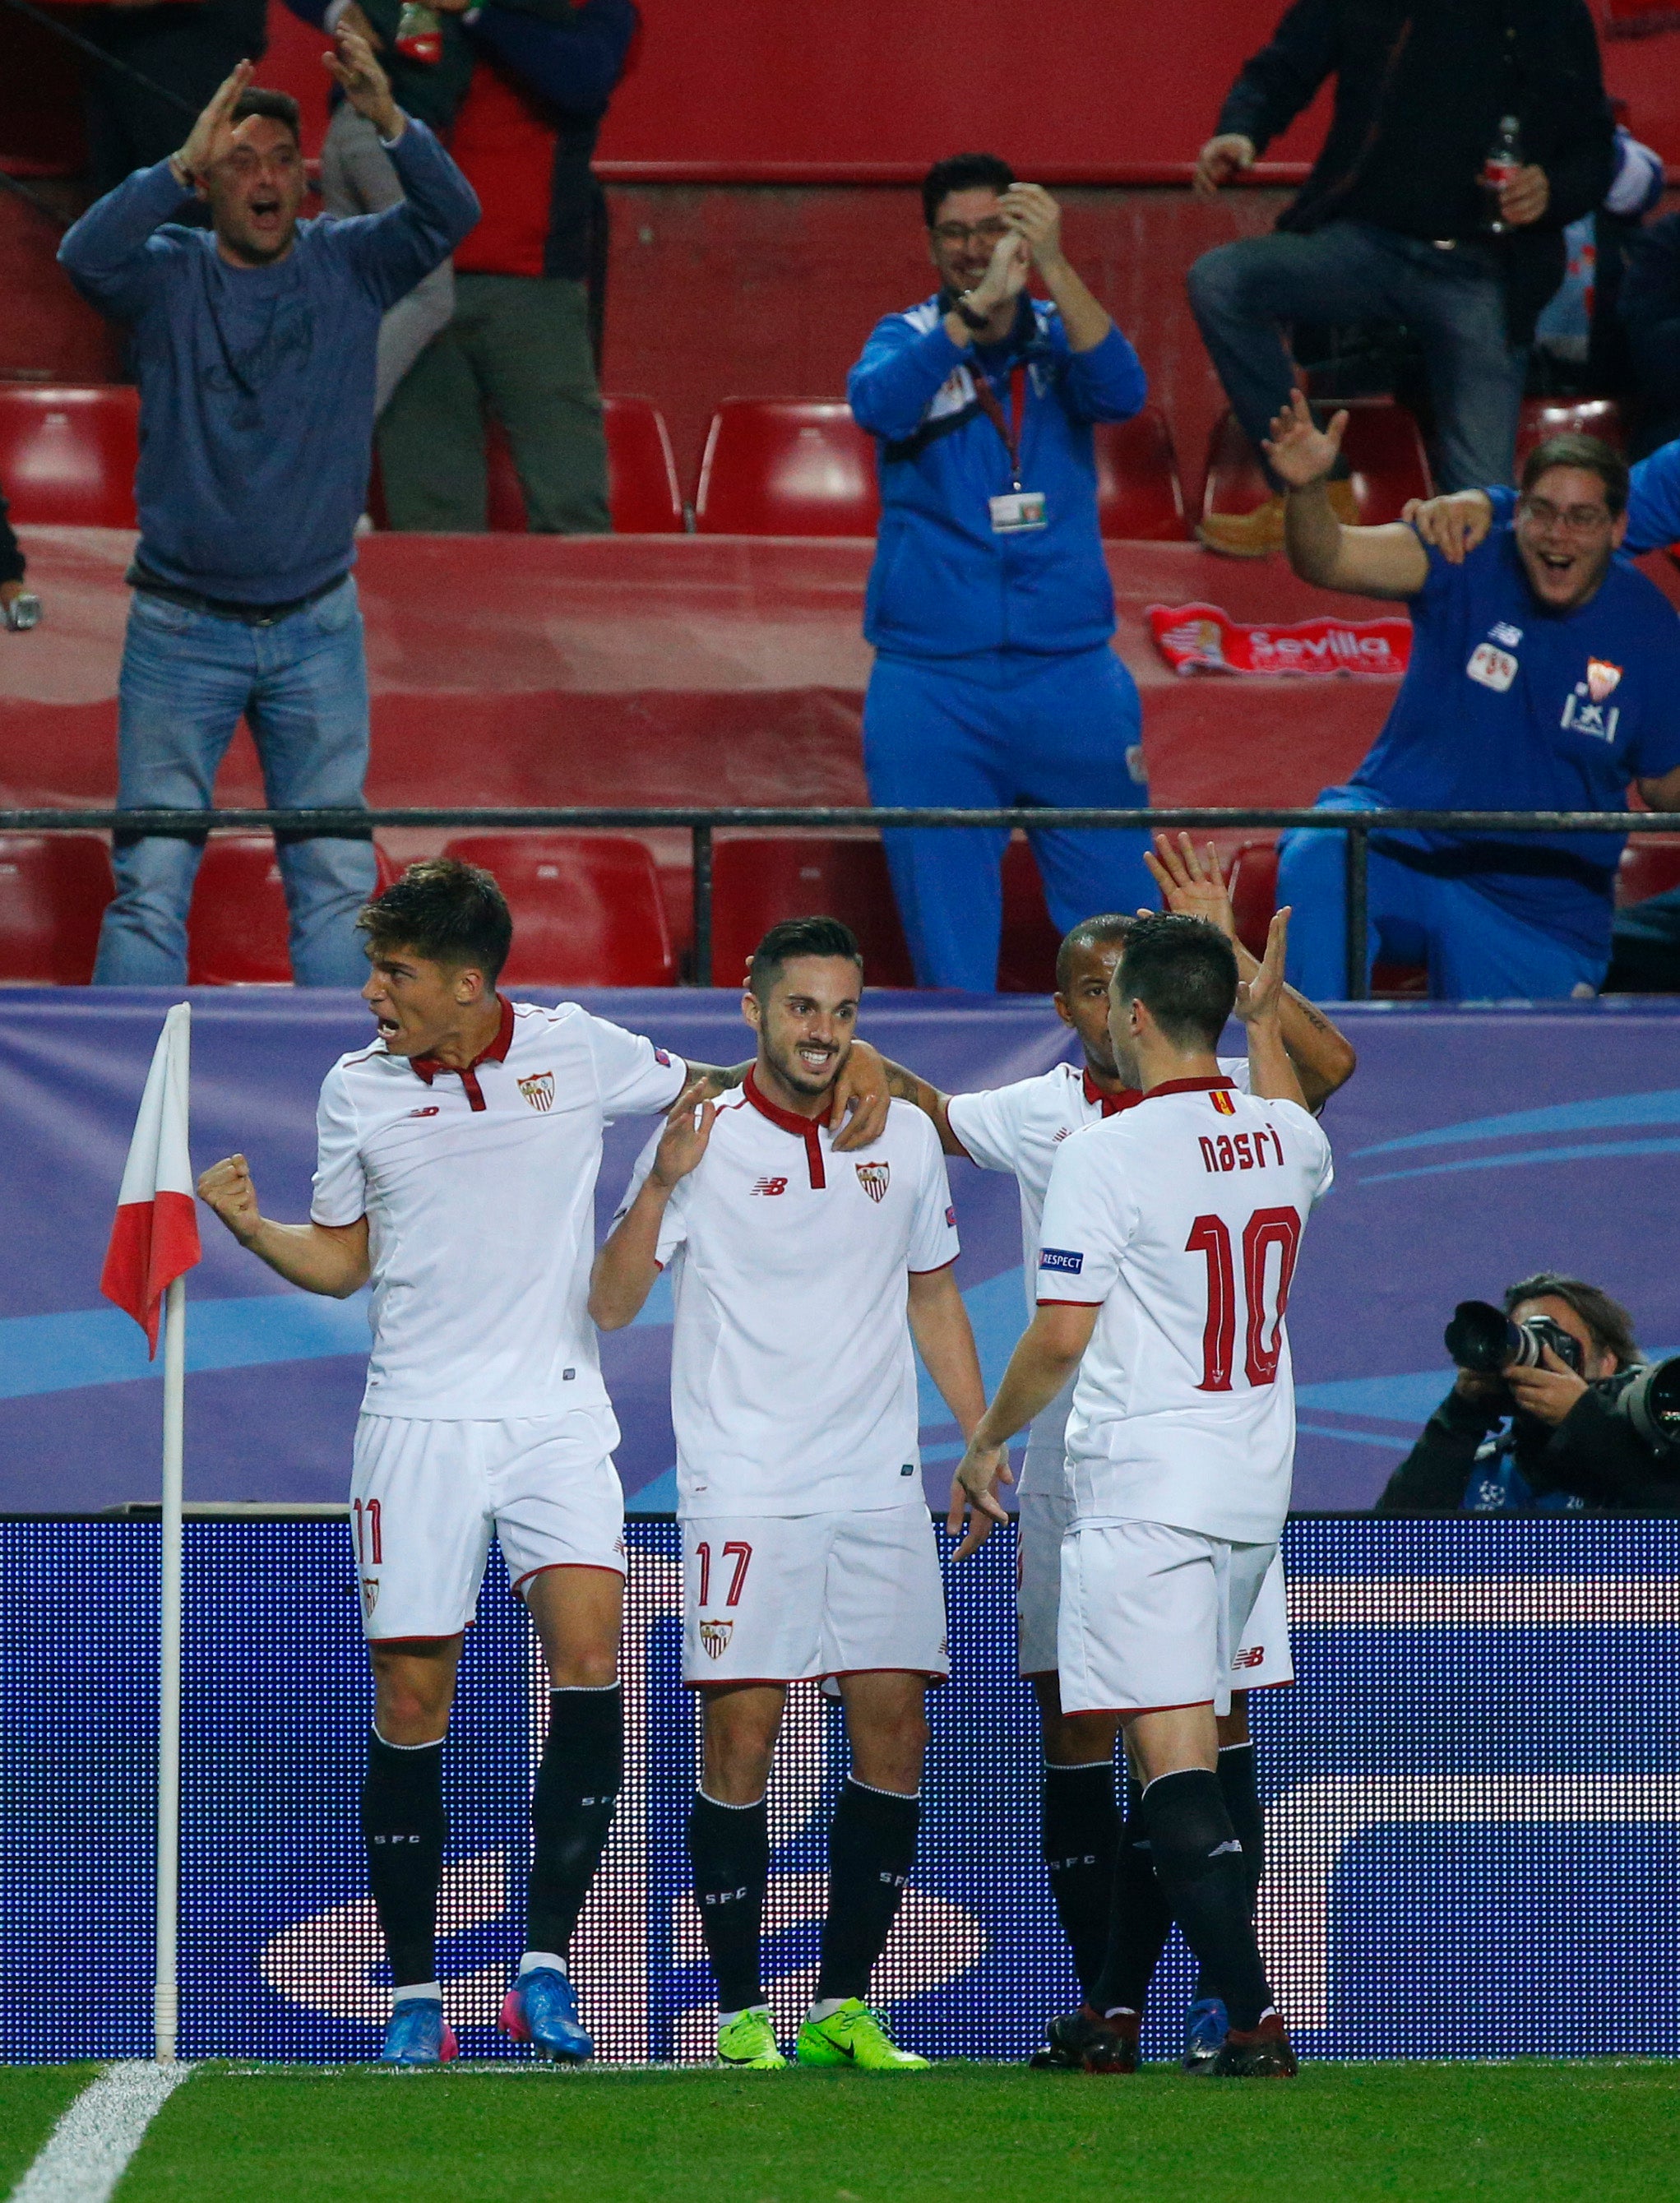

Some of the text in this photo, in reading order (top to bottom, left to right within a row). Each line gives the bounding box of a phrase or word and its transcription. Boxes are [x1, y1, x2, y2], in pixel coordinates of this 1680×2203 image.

[1249, 628, 1391, 657] Sevilla
[1198, 1122, 1284, 1173] nasri
[1044, 1253, 1081, 1269] RESPECT
[1184, 1206, 1301, 1391] 10
[353, 1497, 382, 1564] 11
[696, 1542, 752, 1606] 17
